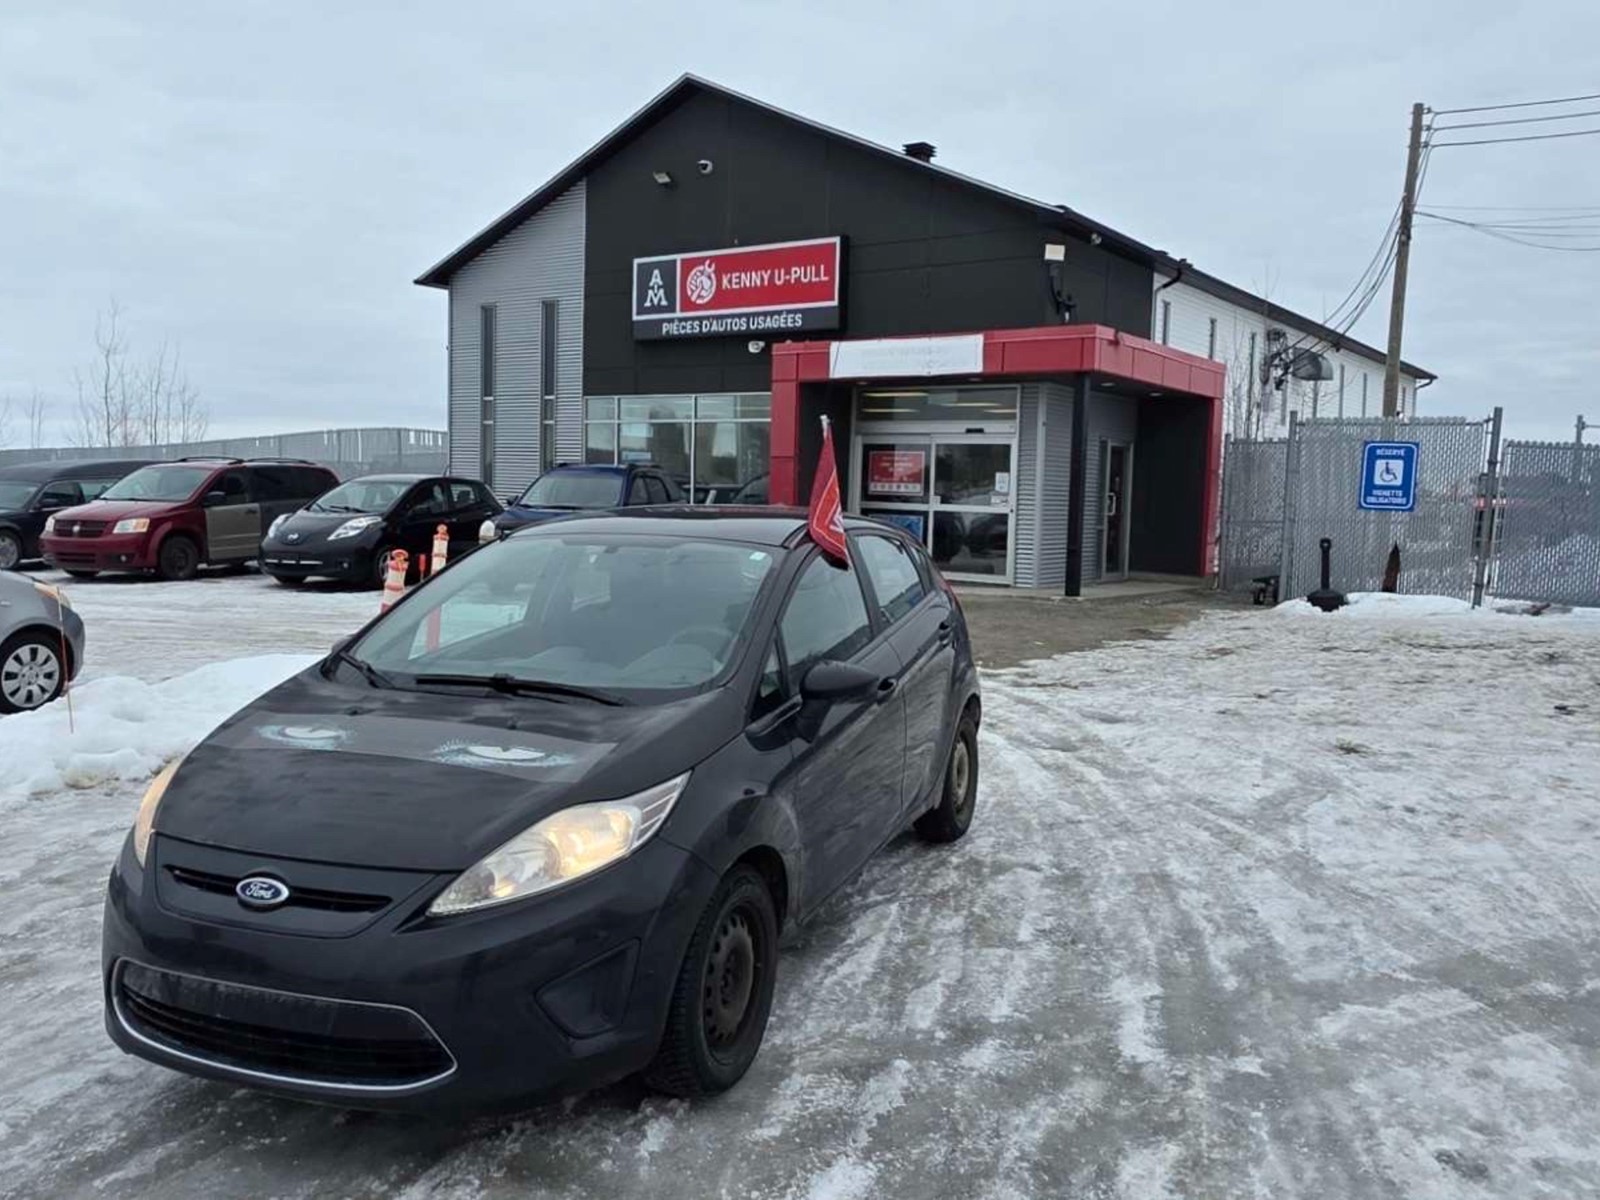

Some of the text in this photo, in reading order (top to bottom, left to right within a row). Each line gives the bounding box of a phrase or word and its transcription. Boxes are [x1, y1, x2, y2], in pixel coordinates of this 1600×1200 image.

[721, 264, 829, 290] KENNY U-PULL
[662, 312, 802, 335] PIÈCES D'AUTOS USAGÉES
[245, 881, 275, 899] Ford
